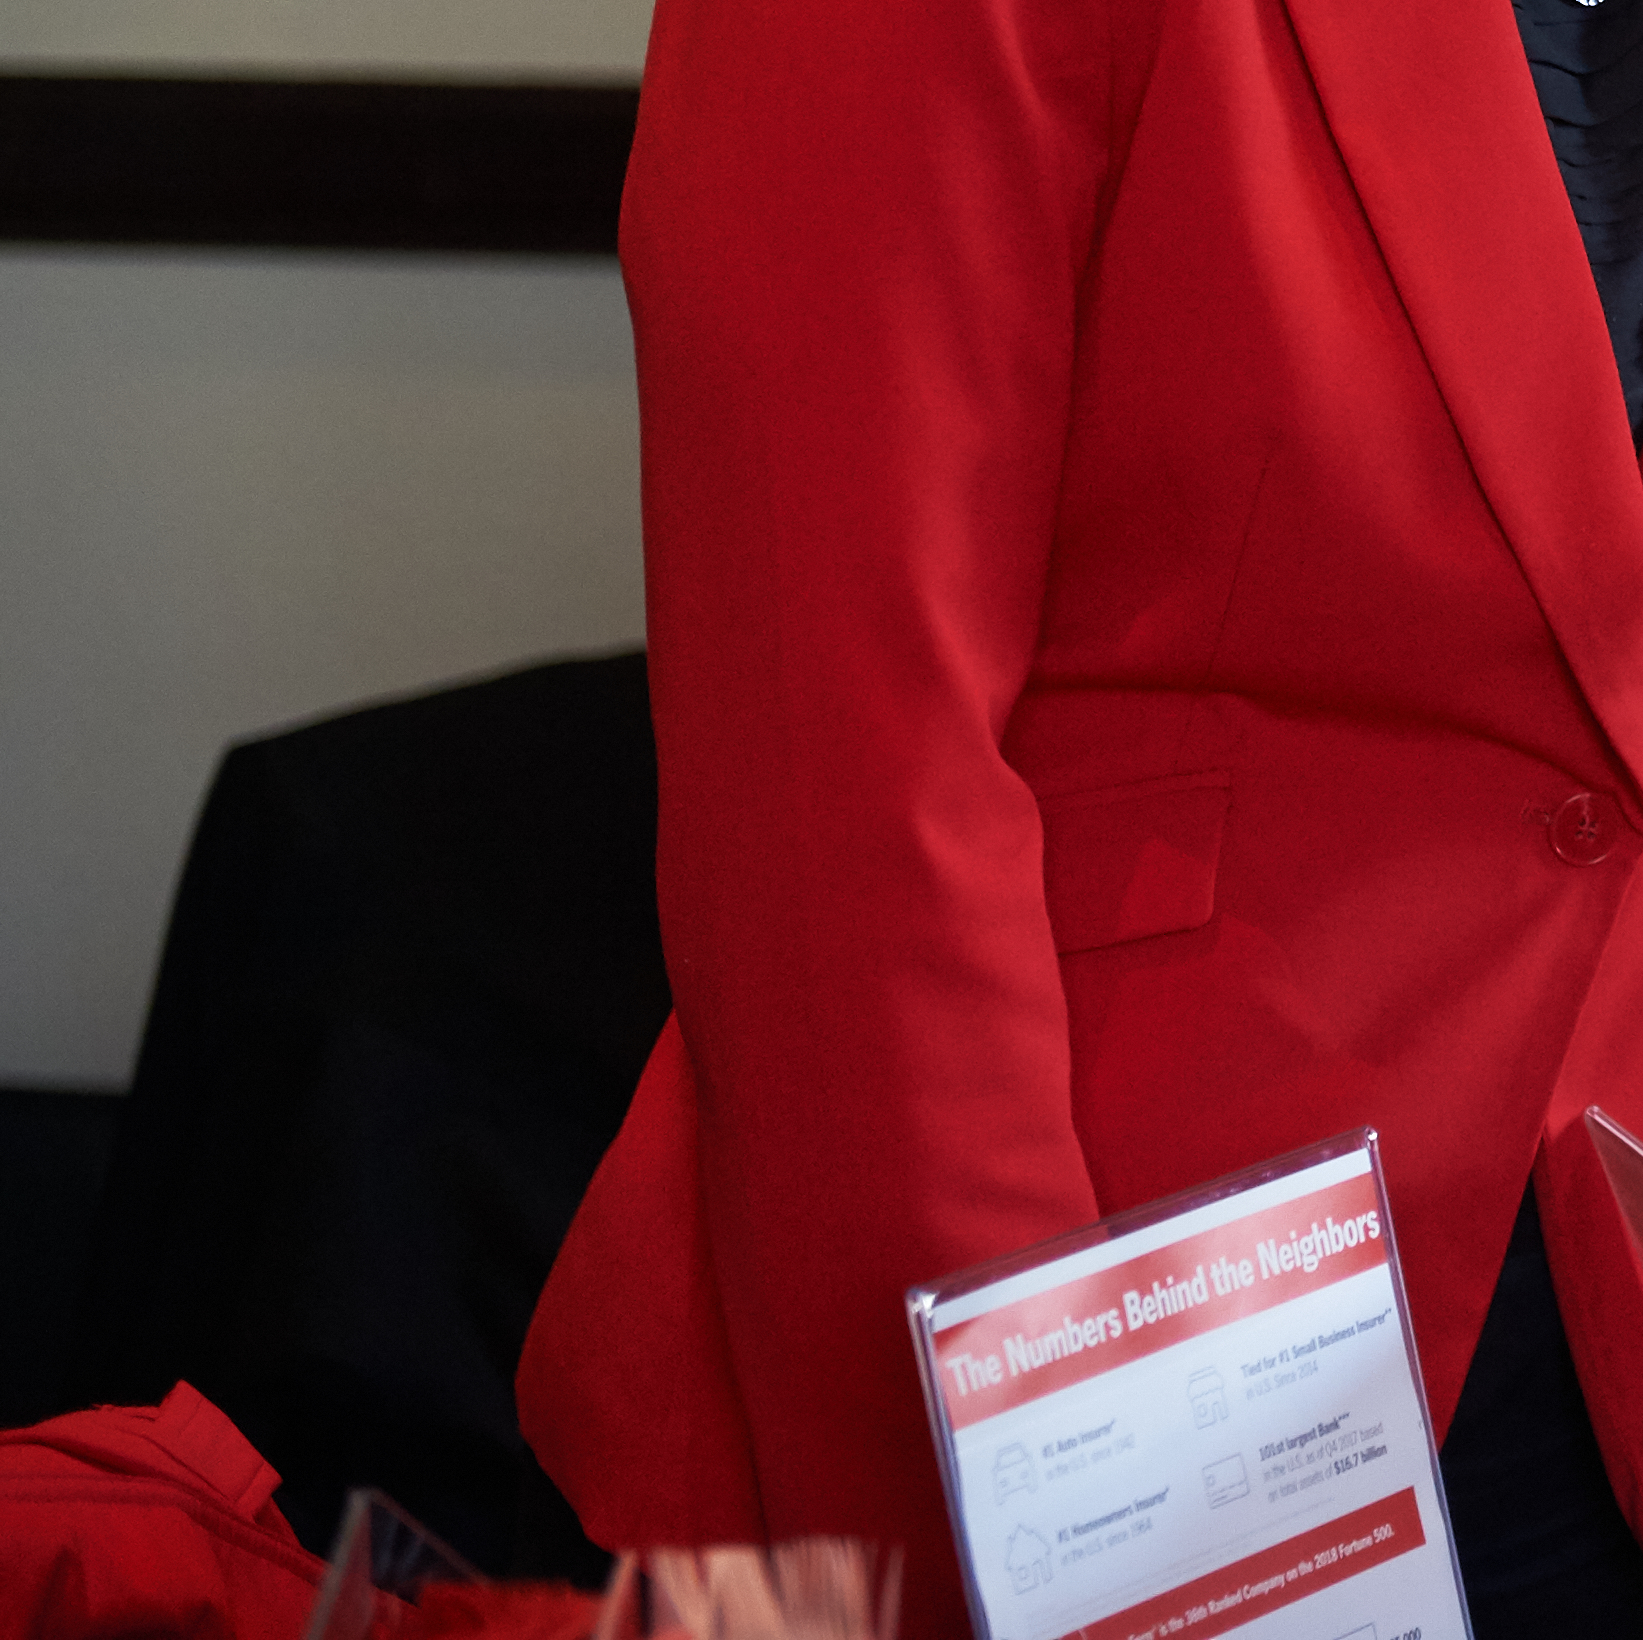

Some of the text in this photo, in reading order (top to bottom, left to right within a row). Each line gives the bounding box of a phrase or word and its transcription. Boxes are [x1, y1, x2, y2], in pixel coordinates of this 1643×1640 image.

[945, 1211, 1381, 1396] The Numbers Behind the Neighbors
[1242, 1573, 1286, 1600] Company
[1313, 1545, 1339, 1570] 2018
[1338, 1535, 1373, 1559] Fortune
